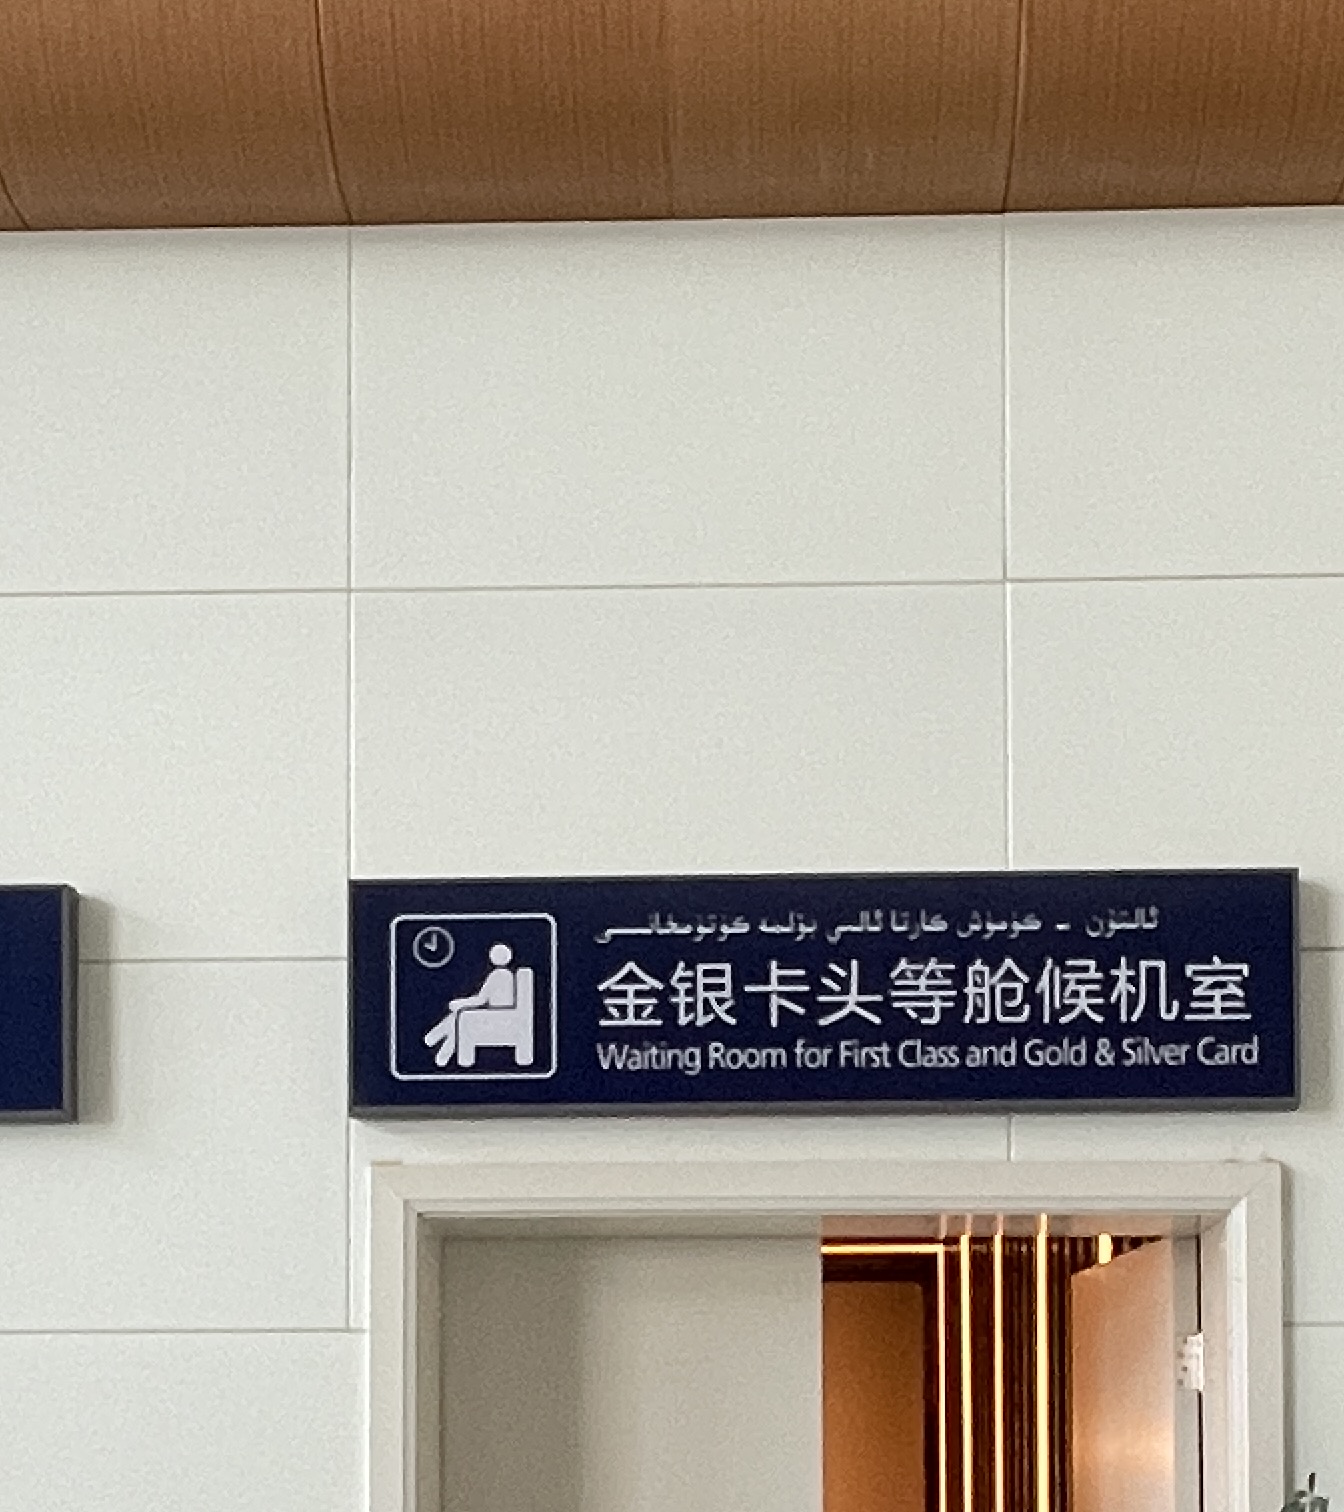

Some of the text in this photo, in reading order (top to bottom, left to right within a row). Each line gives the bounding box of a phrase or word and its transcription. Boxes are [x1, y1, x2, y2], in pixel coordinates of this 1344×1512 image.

[595, 952, 1255, 1030] 金银卡头等舱候机室
[596, 1034, 1261, 1077] Waiting Room for First Class and Gold & Silver Card
